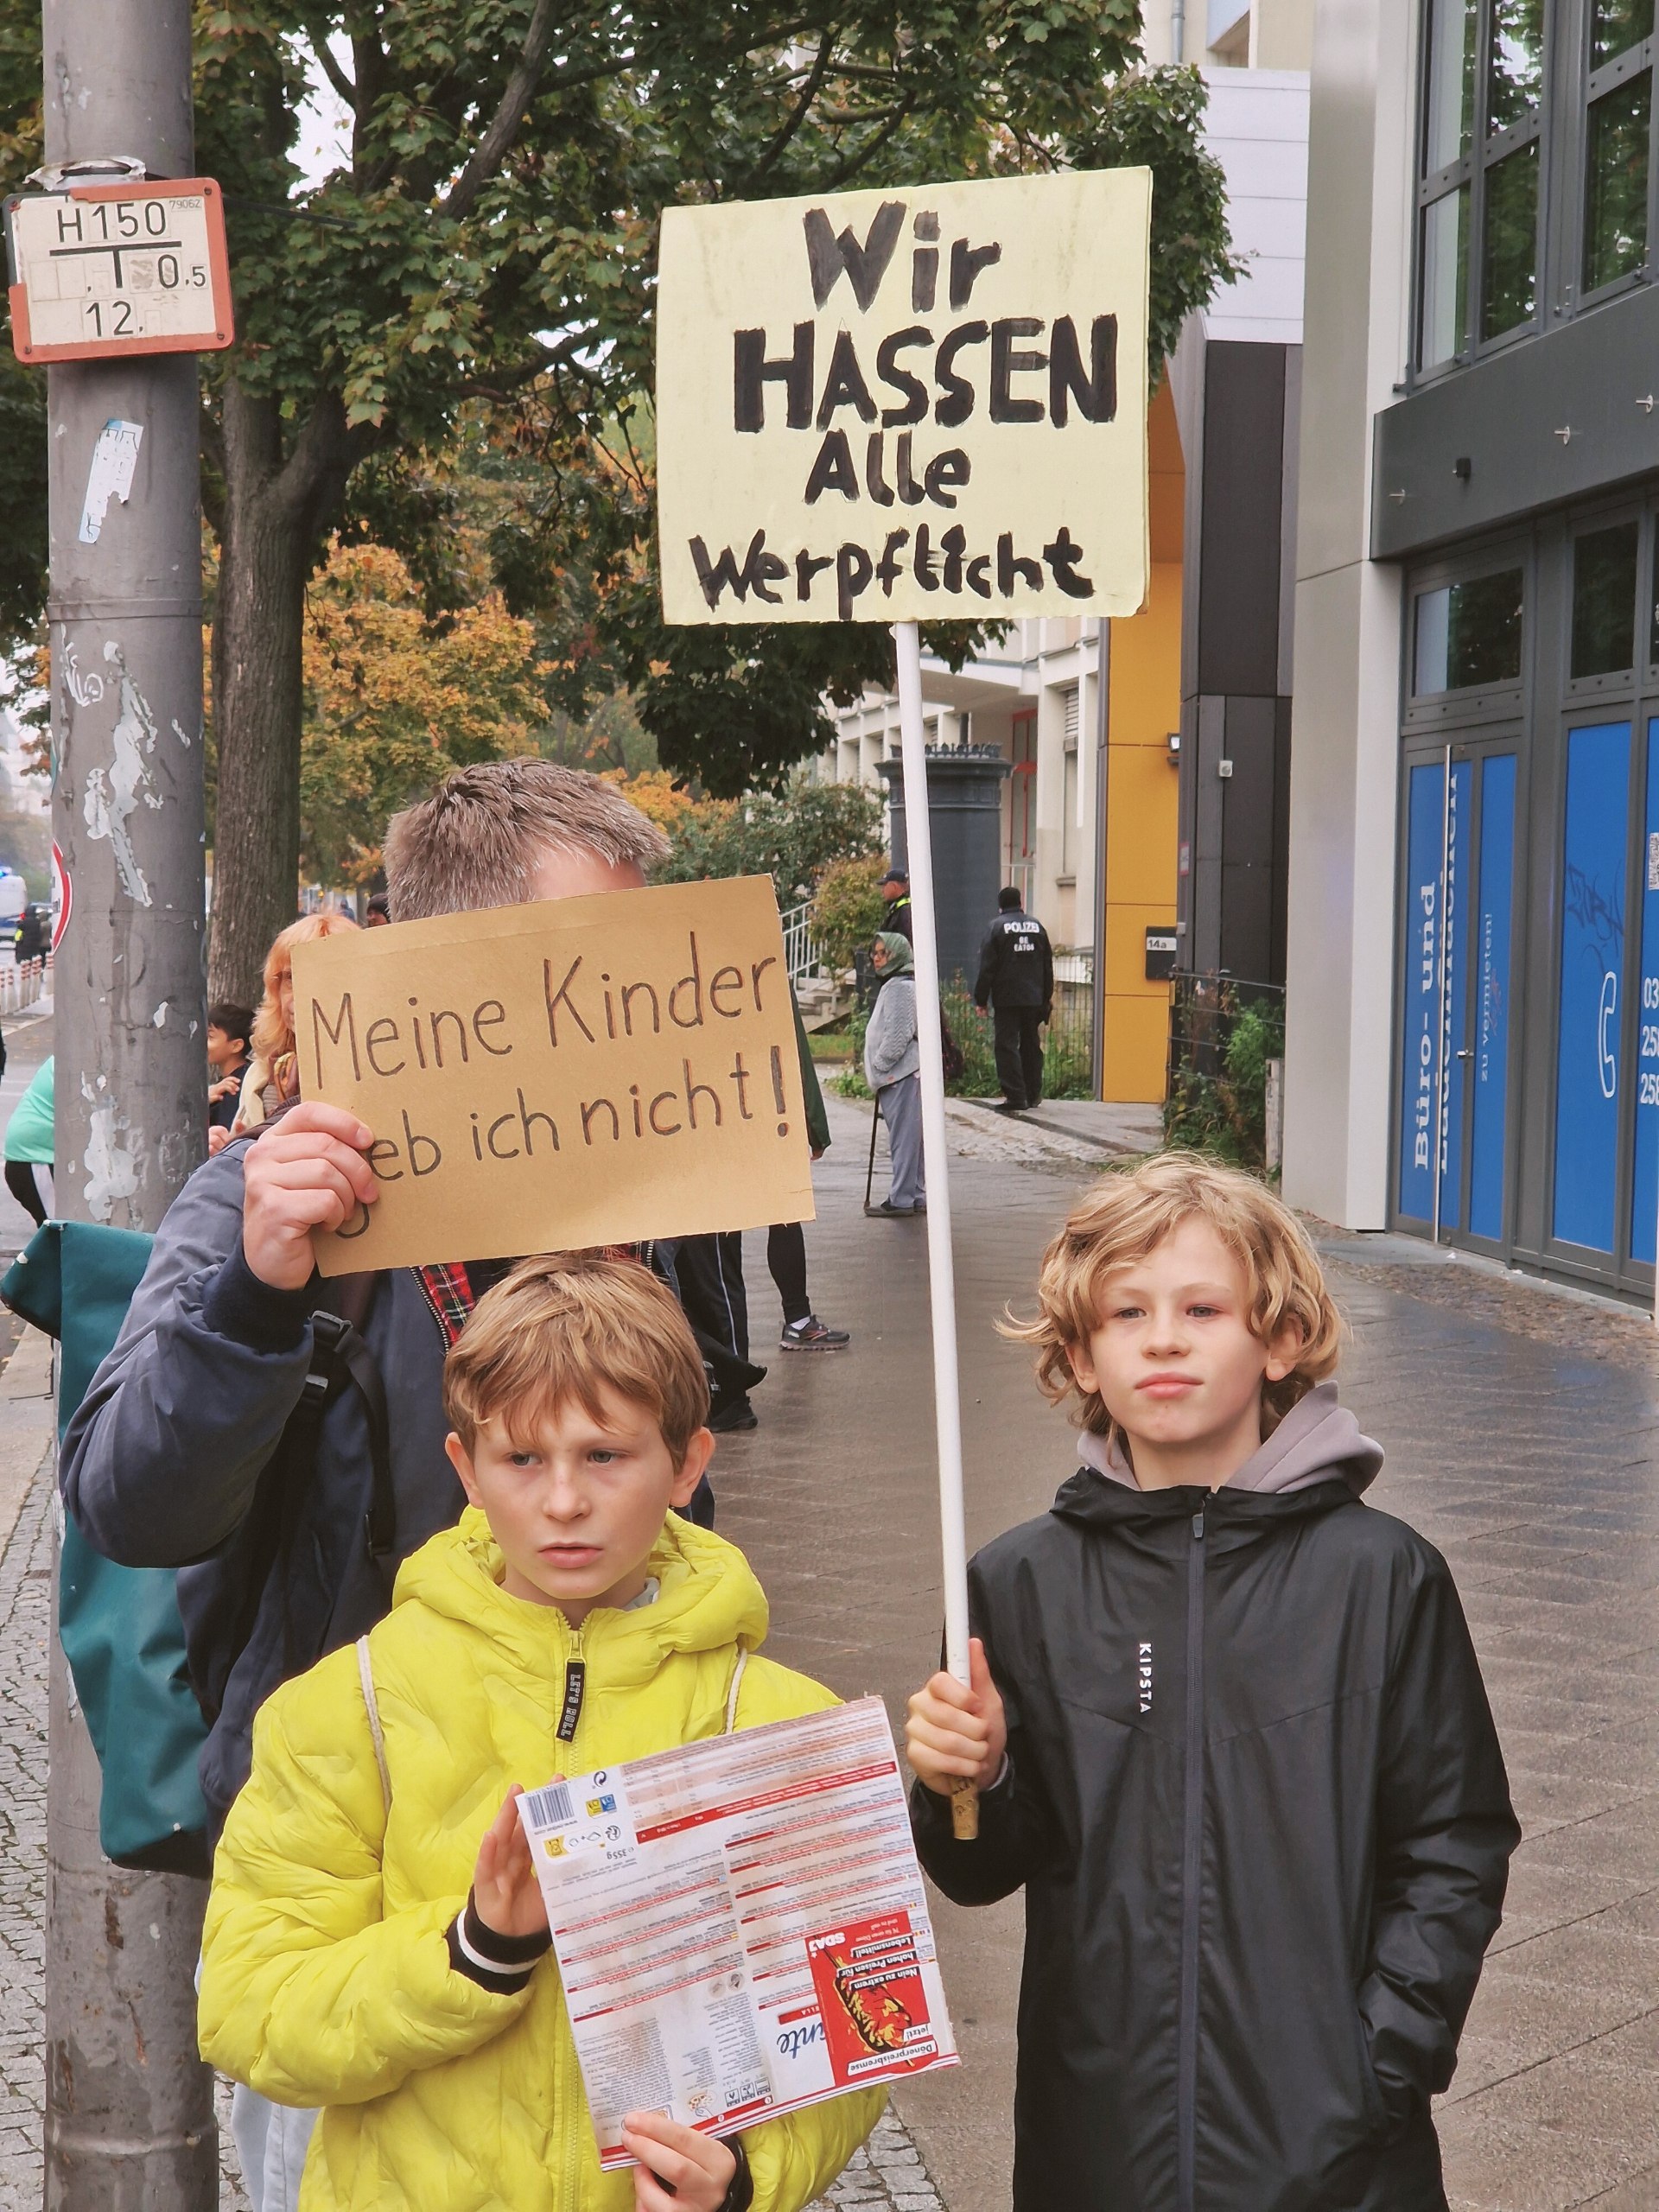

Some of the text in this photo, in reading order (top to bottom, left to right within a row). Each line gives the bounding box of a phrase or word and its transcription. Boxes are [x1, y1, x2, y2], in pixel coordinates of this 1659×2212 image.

[57, 201, 167, 242] H150
[168, 199, 201, 209] 79062
[802, 200, 1001, 315] Wir
[734, 313, 1117, 434] HASSEN
[804, 429, 971, 509] Alle
[1147, 939, 1166, 949] 14a
[1421, 881, 1436, 994] und
[311, 931, 777, 1090] Meine Kinder
[1641, 1025, 1658, 1057] 25
[1482, 1053, 1491, 1083] zu
[469, 1088, 560, 1161] ich
[581, 1046, 789, 1146] nicht!
[1139, 1643, 1152, 1713] KIPSTA
[561, 1674, 582, 1737] LET'S ROLL
[855, 1959, 887, 1972] Preisen
[887, 1953, 914, 1963] hohen
[854, 1967, 918, 1989] Nein zu extrem
[906, 2024, 930, 2040] jetzt!
[849, 2044, 933, 2072] Dönerpreisbremse
